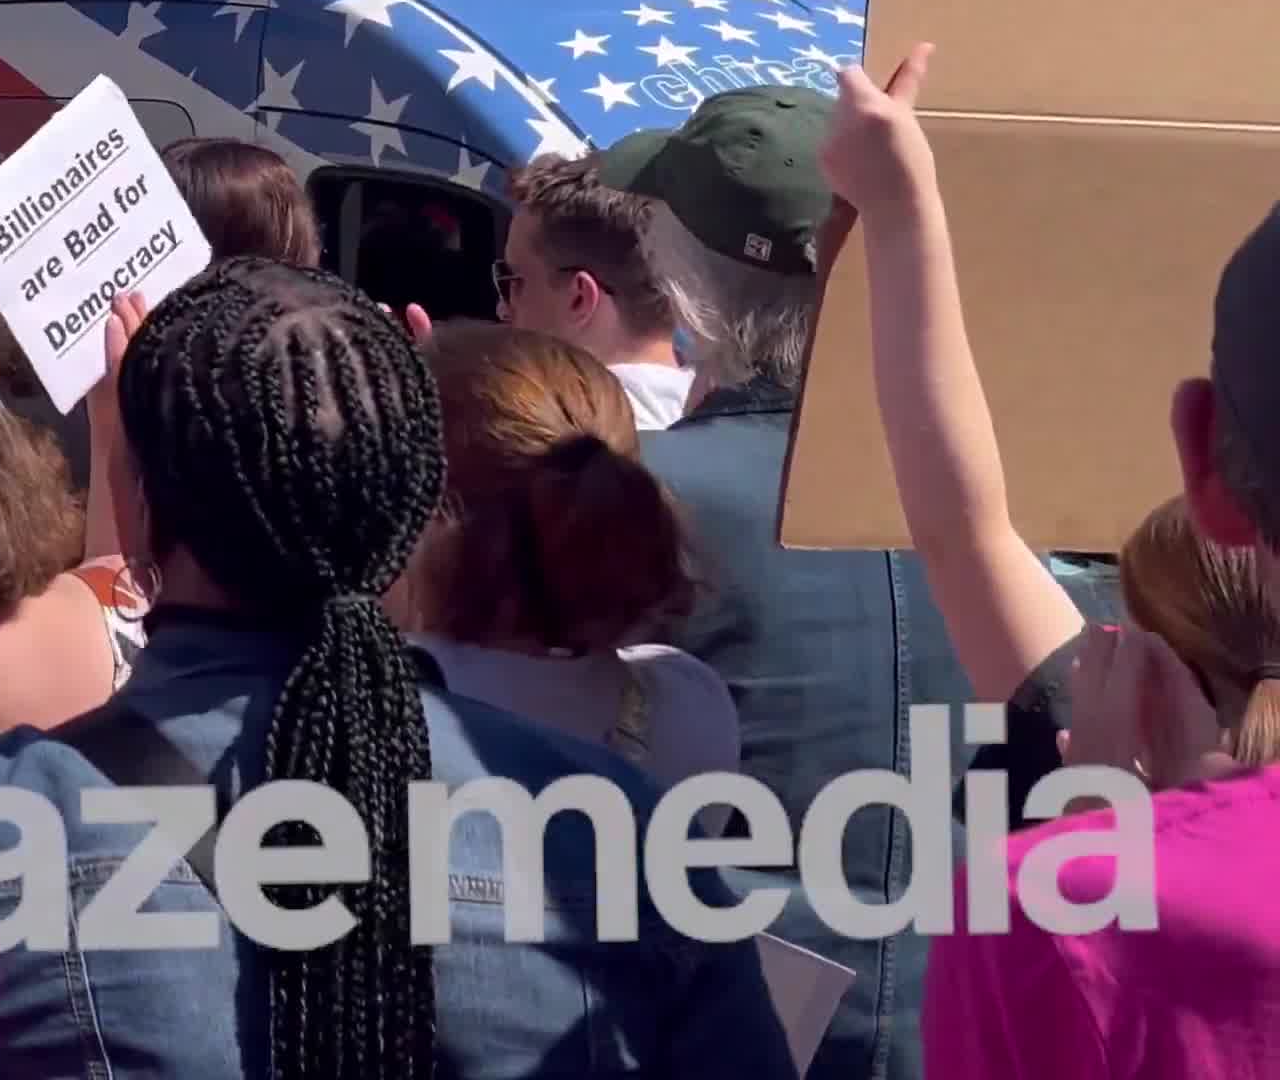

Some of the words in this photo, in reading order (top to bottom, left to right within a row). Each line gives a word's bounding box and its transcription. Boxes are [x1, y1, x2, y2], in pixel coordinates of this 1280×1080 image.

[20, 254, 64, 302] are
[63, 202, 115, 261] Bad
[113, 174, 149, 214] for
[43, 220, 178, 351] Democracy
